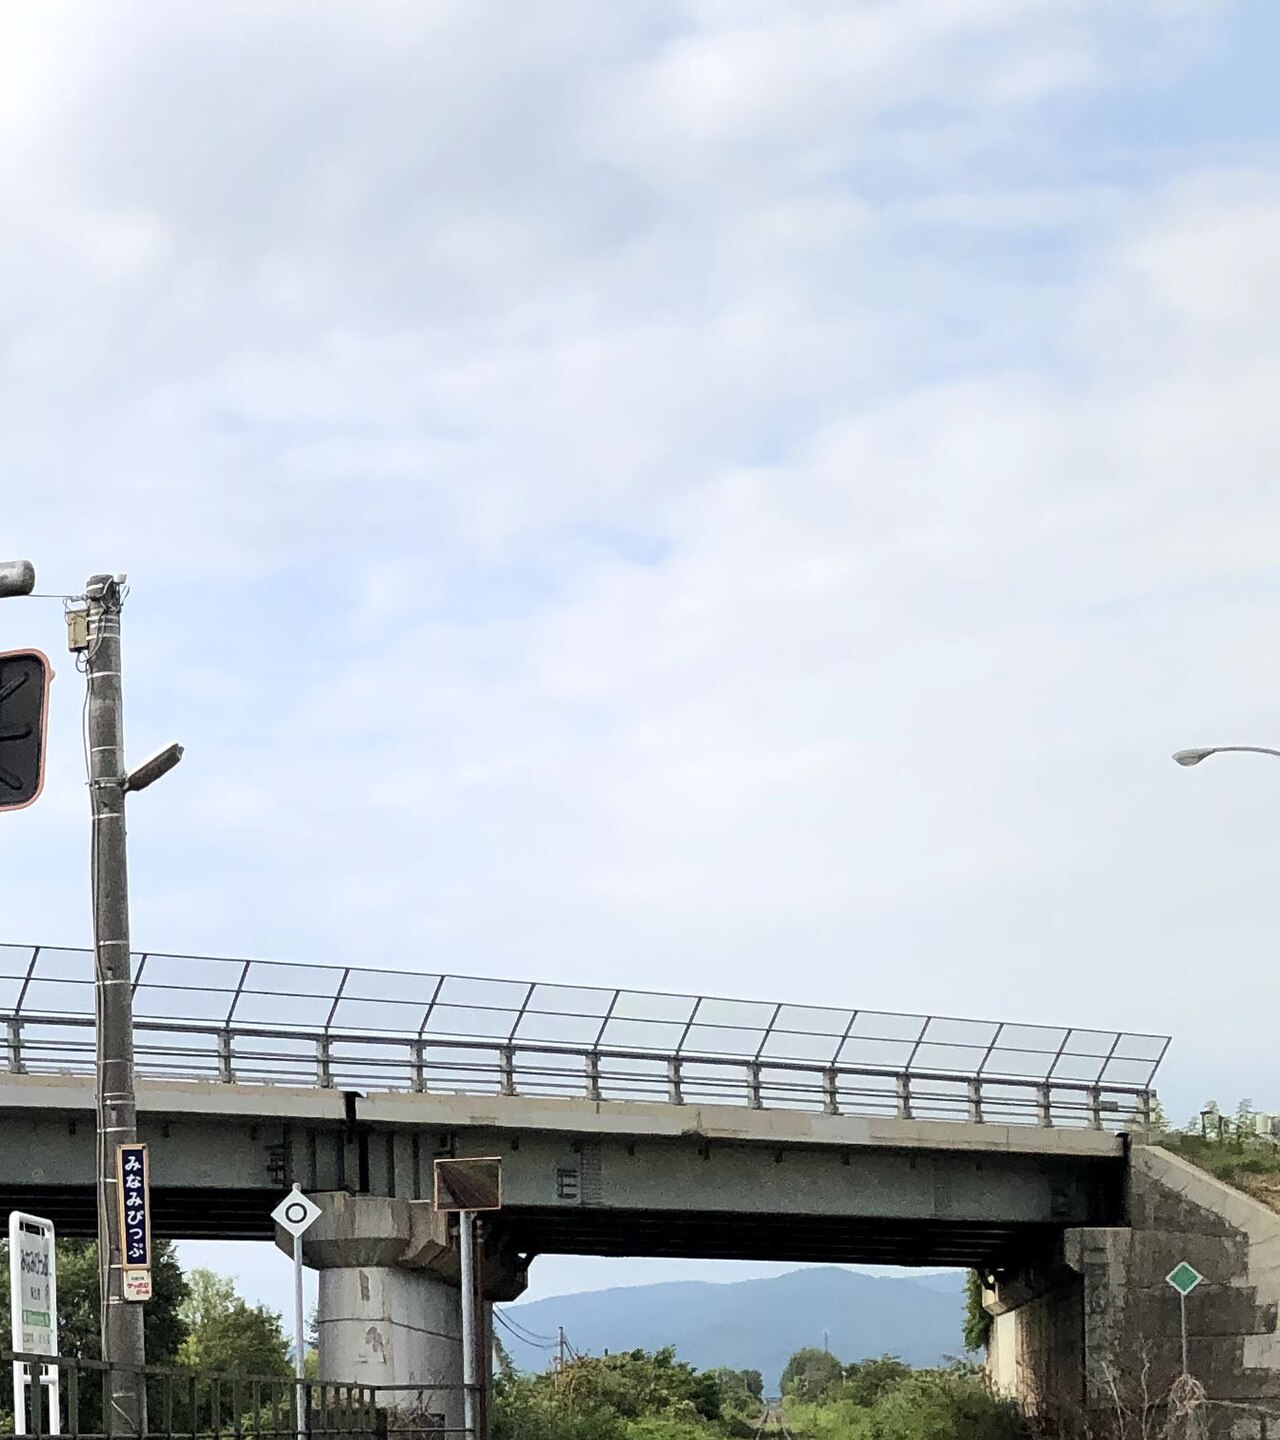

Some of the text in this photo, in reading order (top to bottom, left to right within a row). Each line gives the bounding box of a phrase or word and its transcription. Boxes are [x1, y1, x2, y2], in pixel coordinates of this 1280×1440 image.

[124, 1156, 145, 1258] みなみぴっぷ
